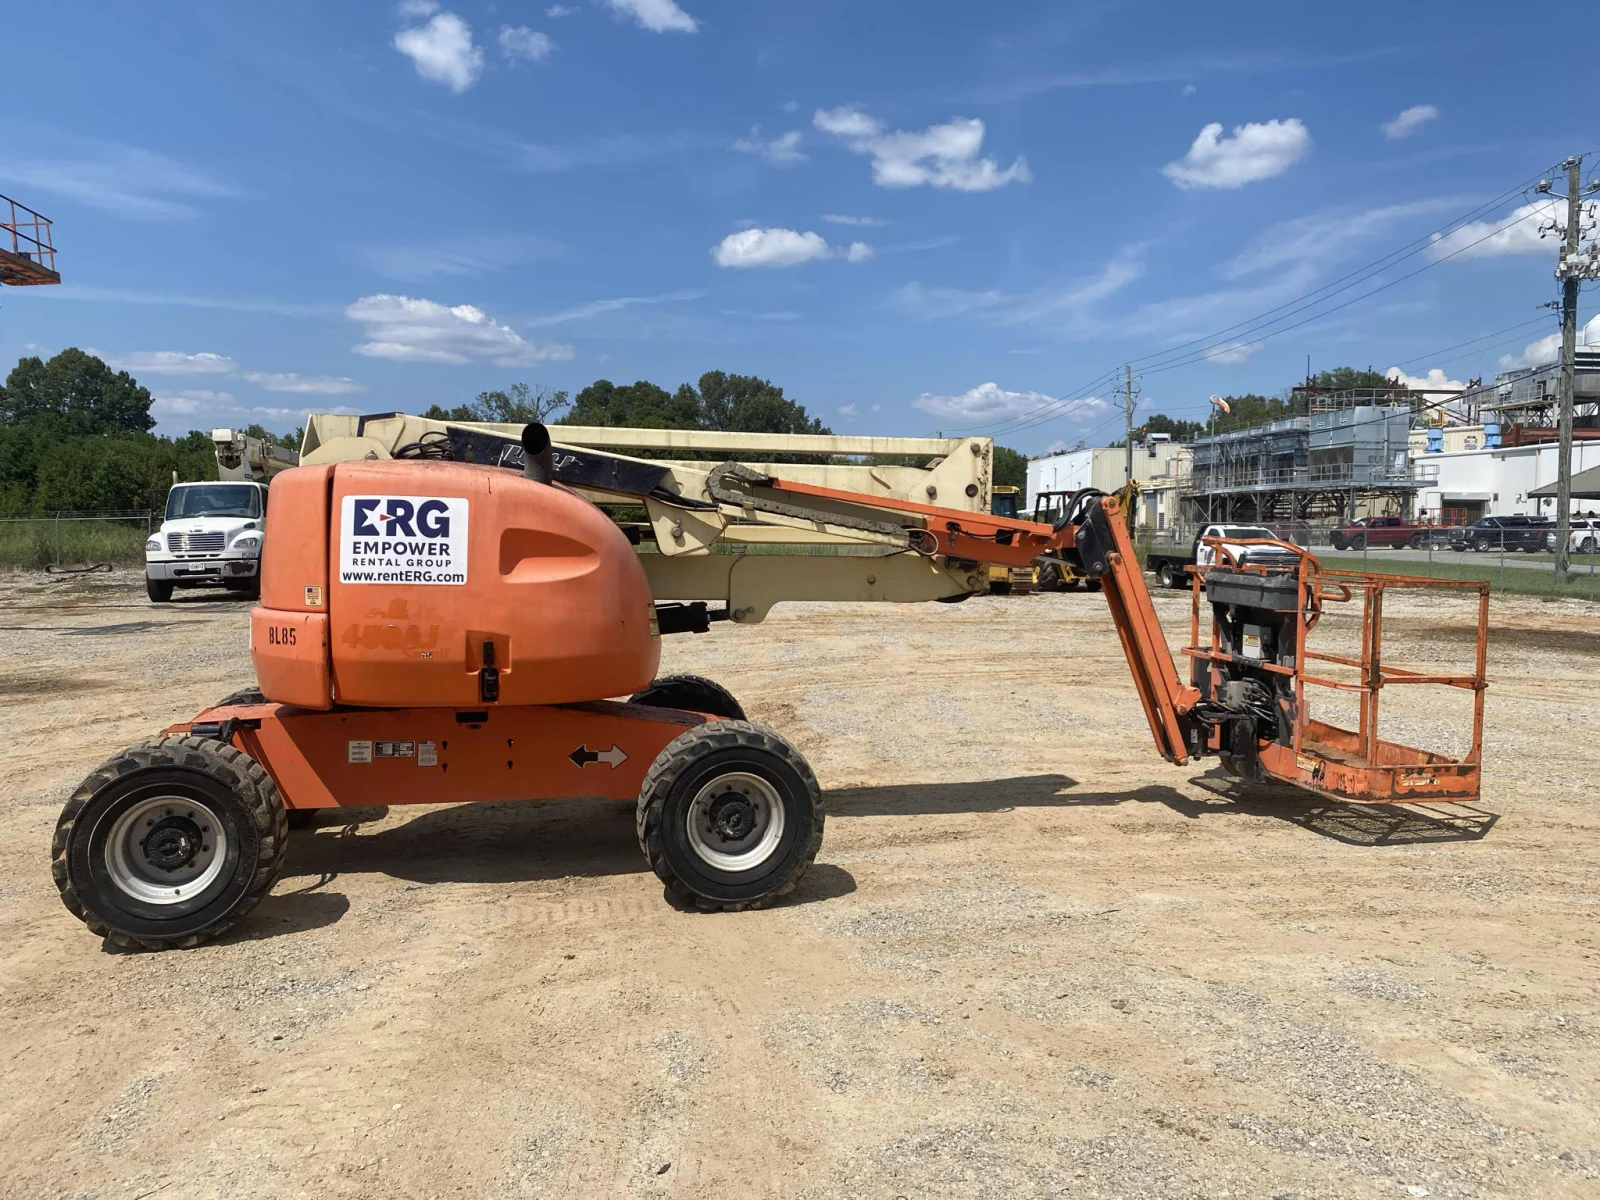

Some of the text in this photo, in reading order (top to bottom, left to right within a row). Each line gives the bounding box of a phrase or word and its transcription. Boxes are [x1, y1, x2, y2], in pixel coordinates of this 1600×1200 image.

[353, 499, 450, 538] ERG
[352, 541, 450, 556] EMPOWER
[352, 558, 452, 567] RENTAL GROUP
[342, 571, 464, 583] www.rentERG.com
[269, 626, 296, 646] BL85
